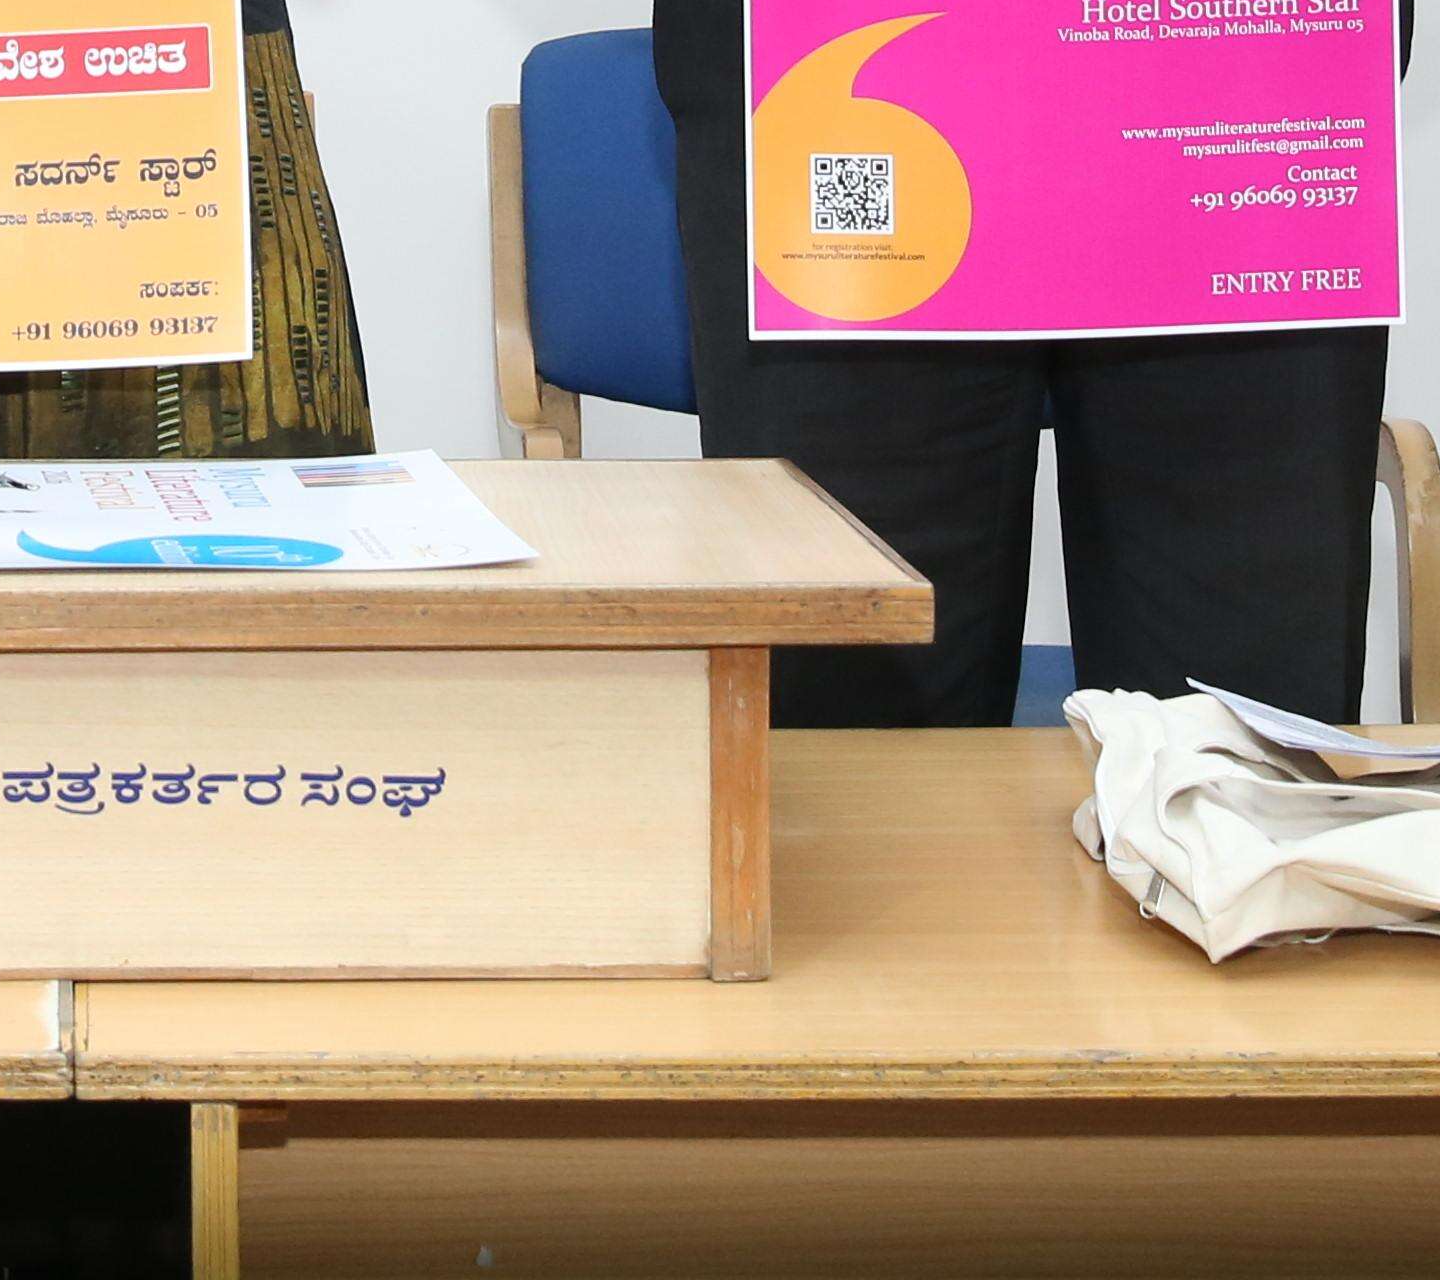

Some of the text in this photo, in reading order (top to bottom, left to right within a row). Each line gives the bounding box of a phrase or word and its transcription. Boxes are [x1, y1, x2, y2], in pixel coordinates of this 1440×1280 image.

[1058, 19, 1364, 42] Vinoba Road, Devaraja Mohalla, Mysuru 05
[84, 40, 186, 76] ಉಚಿತ
[1122, 116, 1365, 140] www.mysuruliteraturefestival.com
[1183, 136, 1363, 159] mysurulitfest@gmail.com
[15, 153, 120, 188] ಸದರ್ನ್
[140, 149, 217, 197] ಸ್ಟಾರ್
[1288, 165, 1357, 183] Contact
[1191, 185, 1358, 212] +91 96069 93137
[196, 204, 218, 218] 05
[1212, 269, 1361, 295] ENTRY FREE
[11, 316, 218, 340] +91 96069 93137
[301, 768, 447, 817] ಸಂಘ
